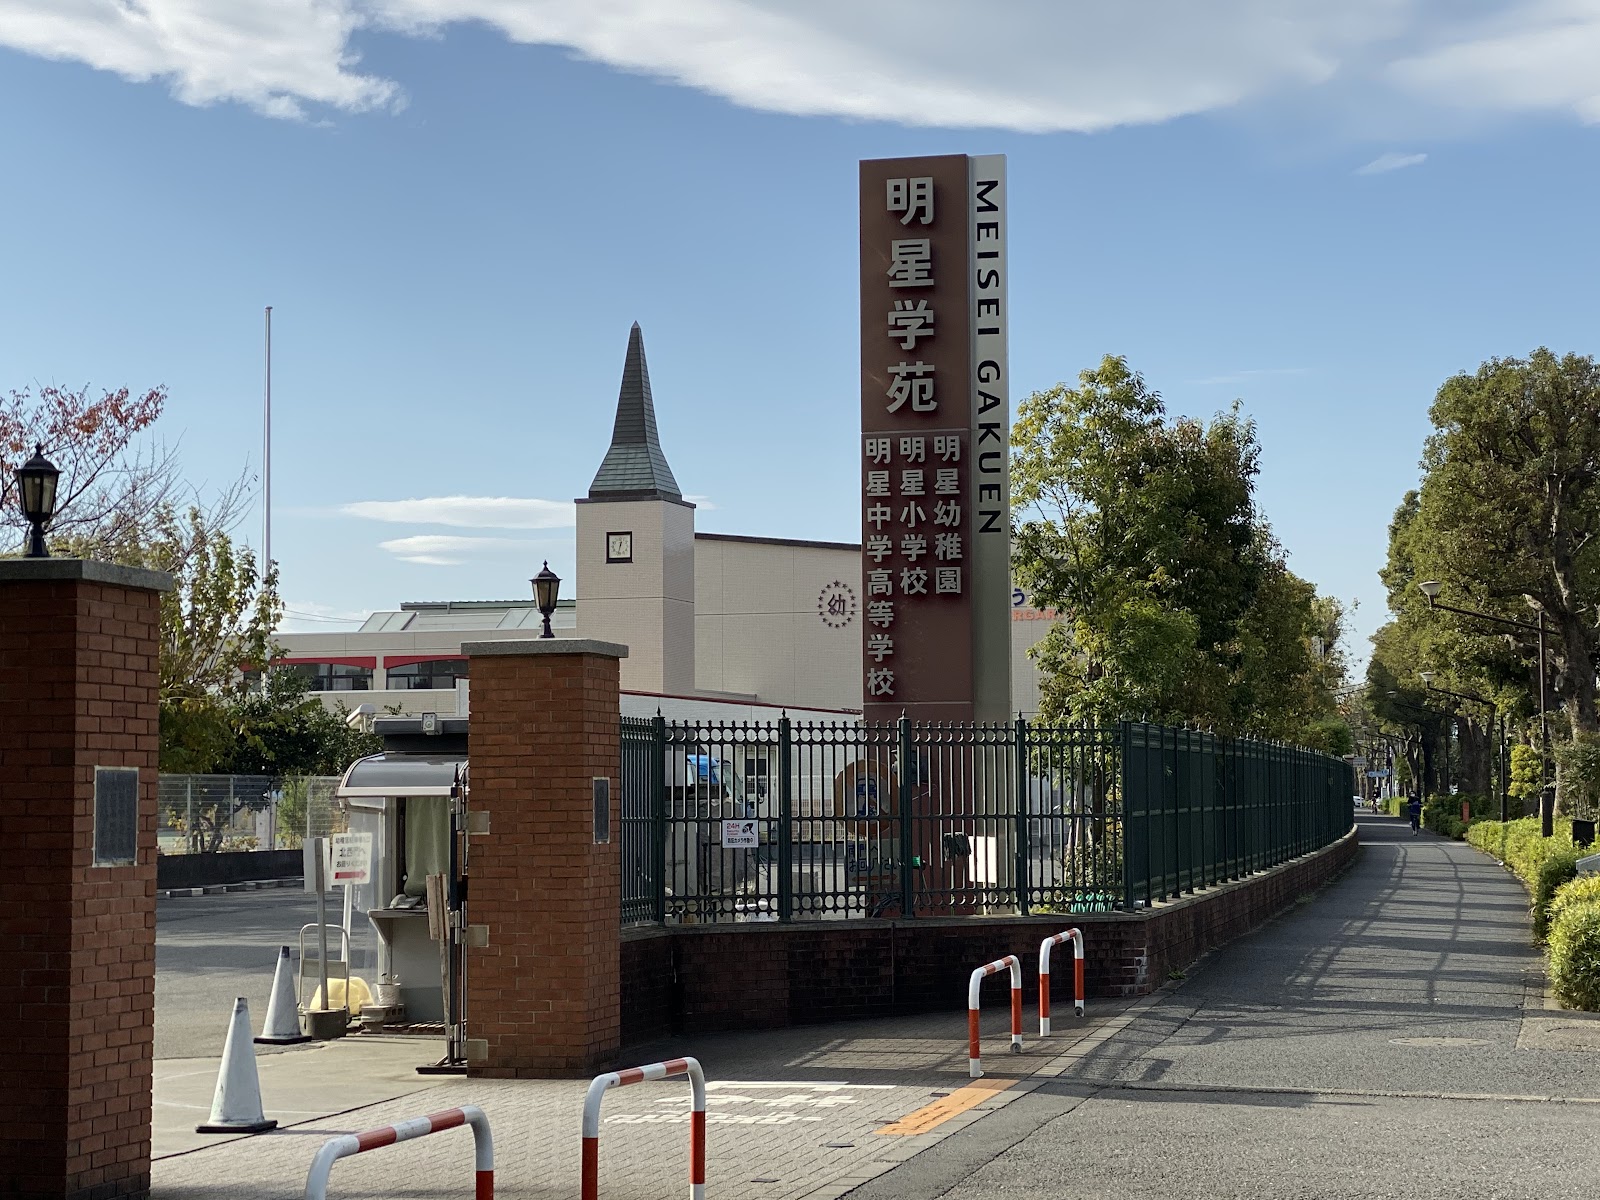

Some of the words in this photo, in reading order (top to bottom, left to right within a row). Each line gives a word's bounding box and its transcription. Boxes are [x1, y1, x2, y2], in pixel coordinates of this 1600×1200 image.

[886, 176, 937, 414] 明星学苑
[976, 180, 1000, 336] MEISEI
[899, 437, 928, 595] 明星小学校
[933, 435, 963, 594] 明星幼稚園
[977, 359, 1002, 534] GAKUEN
[827, 593, 846, 616] 幼
[865, 438, 895, 696] 明星中学高等学校
